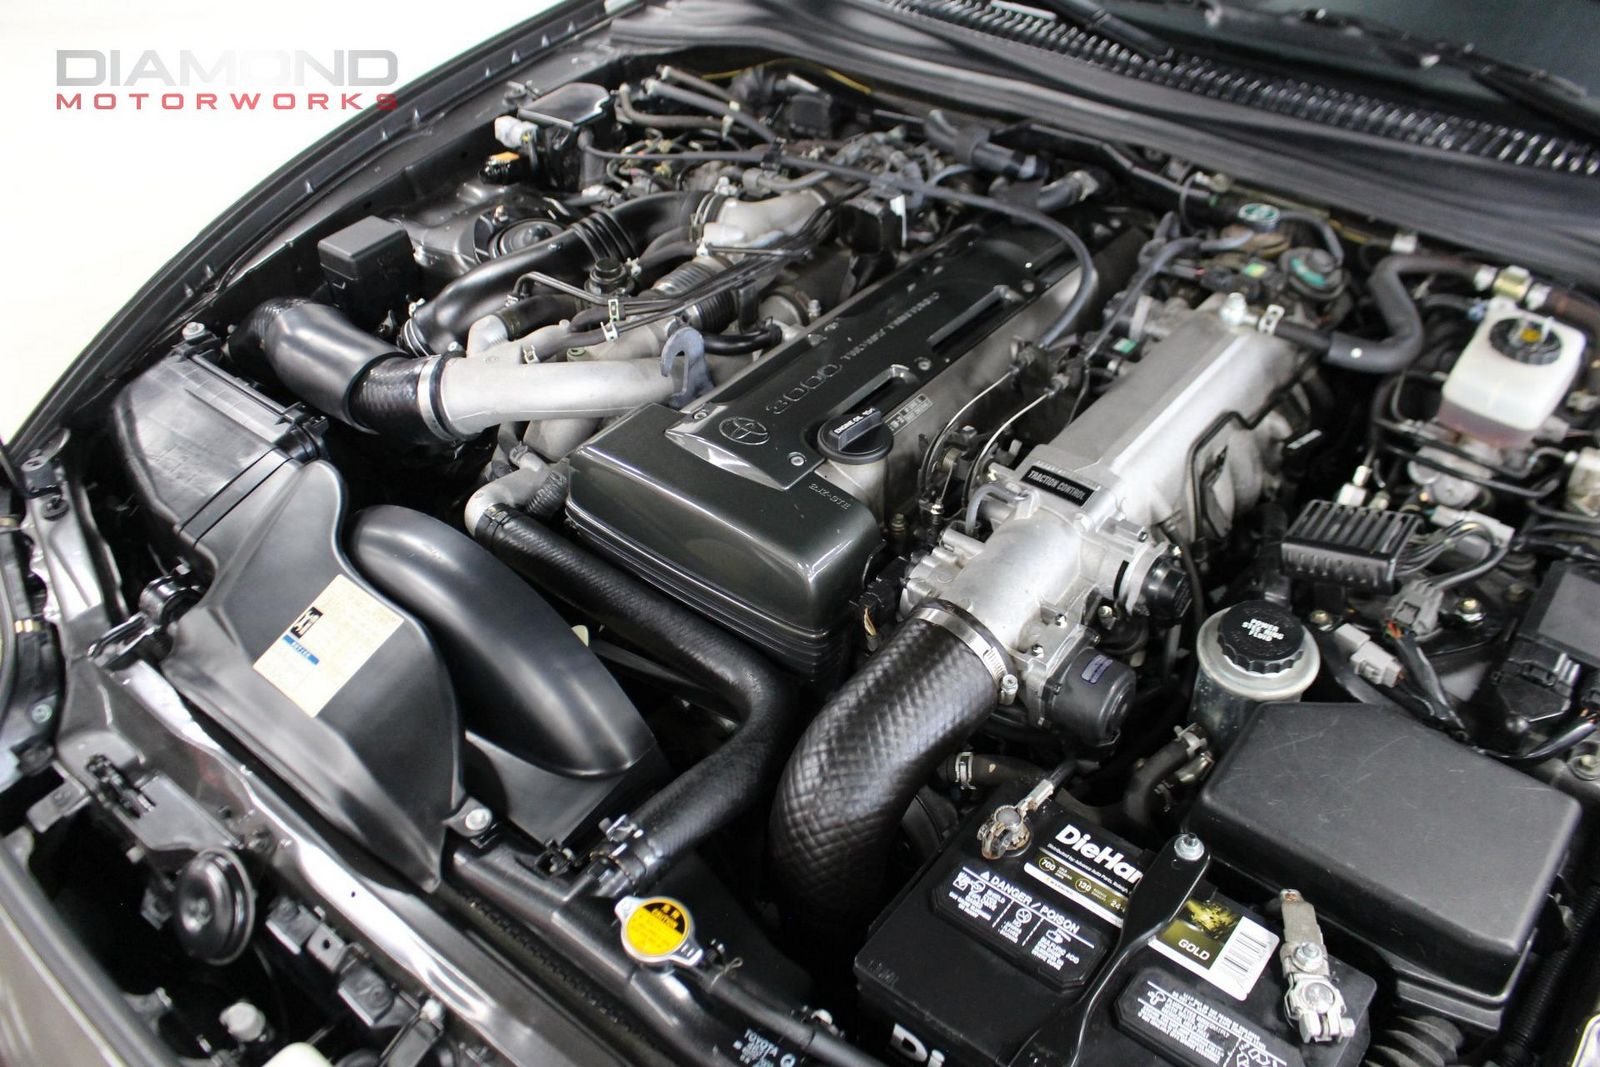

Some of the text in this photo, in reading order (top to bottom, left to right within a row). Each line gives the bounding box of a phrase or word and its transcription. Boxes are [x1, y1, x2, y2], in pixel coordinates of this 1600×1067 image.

[1028, 470, 1086, 500] TRACTION CONTROL
[1041, 860, 1056, 871] 700
[1055, 824, 1143, 883] DieHar
[1078, 880, 1092, 892] 130
[991, 876, 1033, 905] DANGER
[1039, 904, 1080, 934] POISON
[1178, 938, 1211, 961] GOLD
[744, 1028, 779, 1057] TOYOTA
